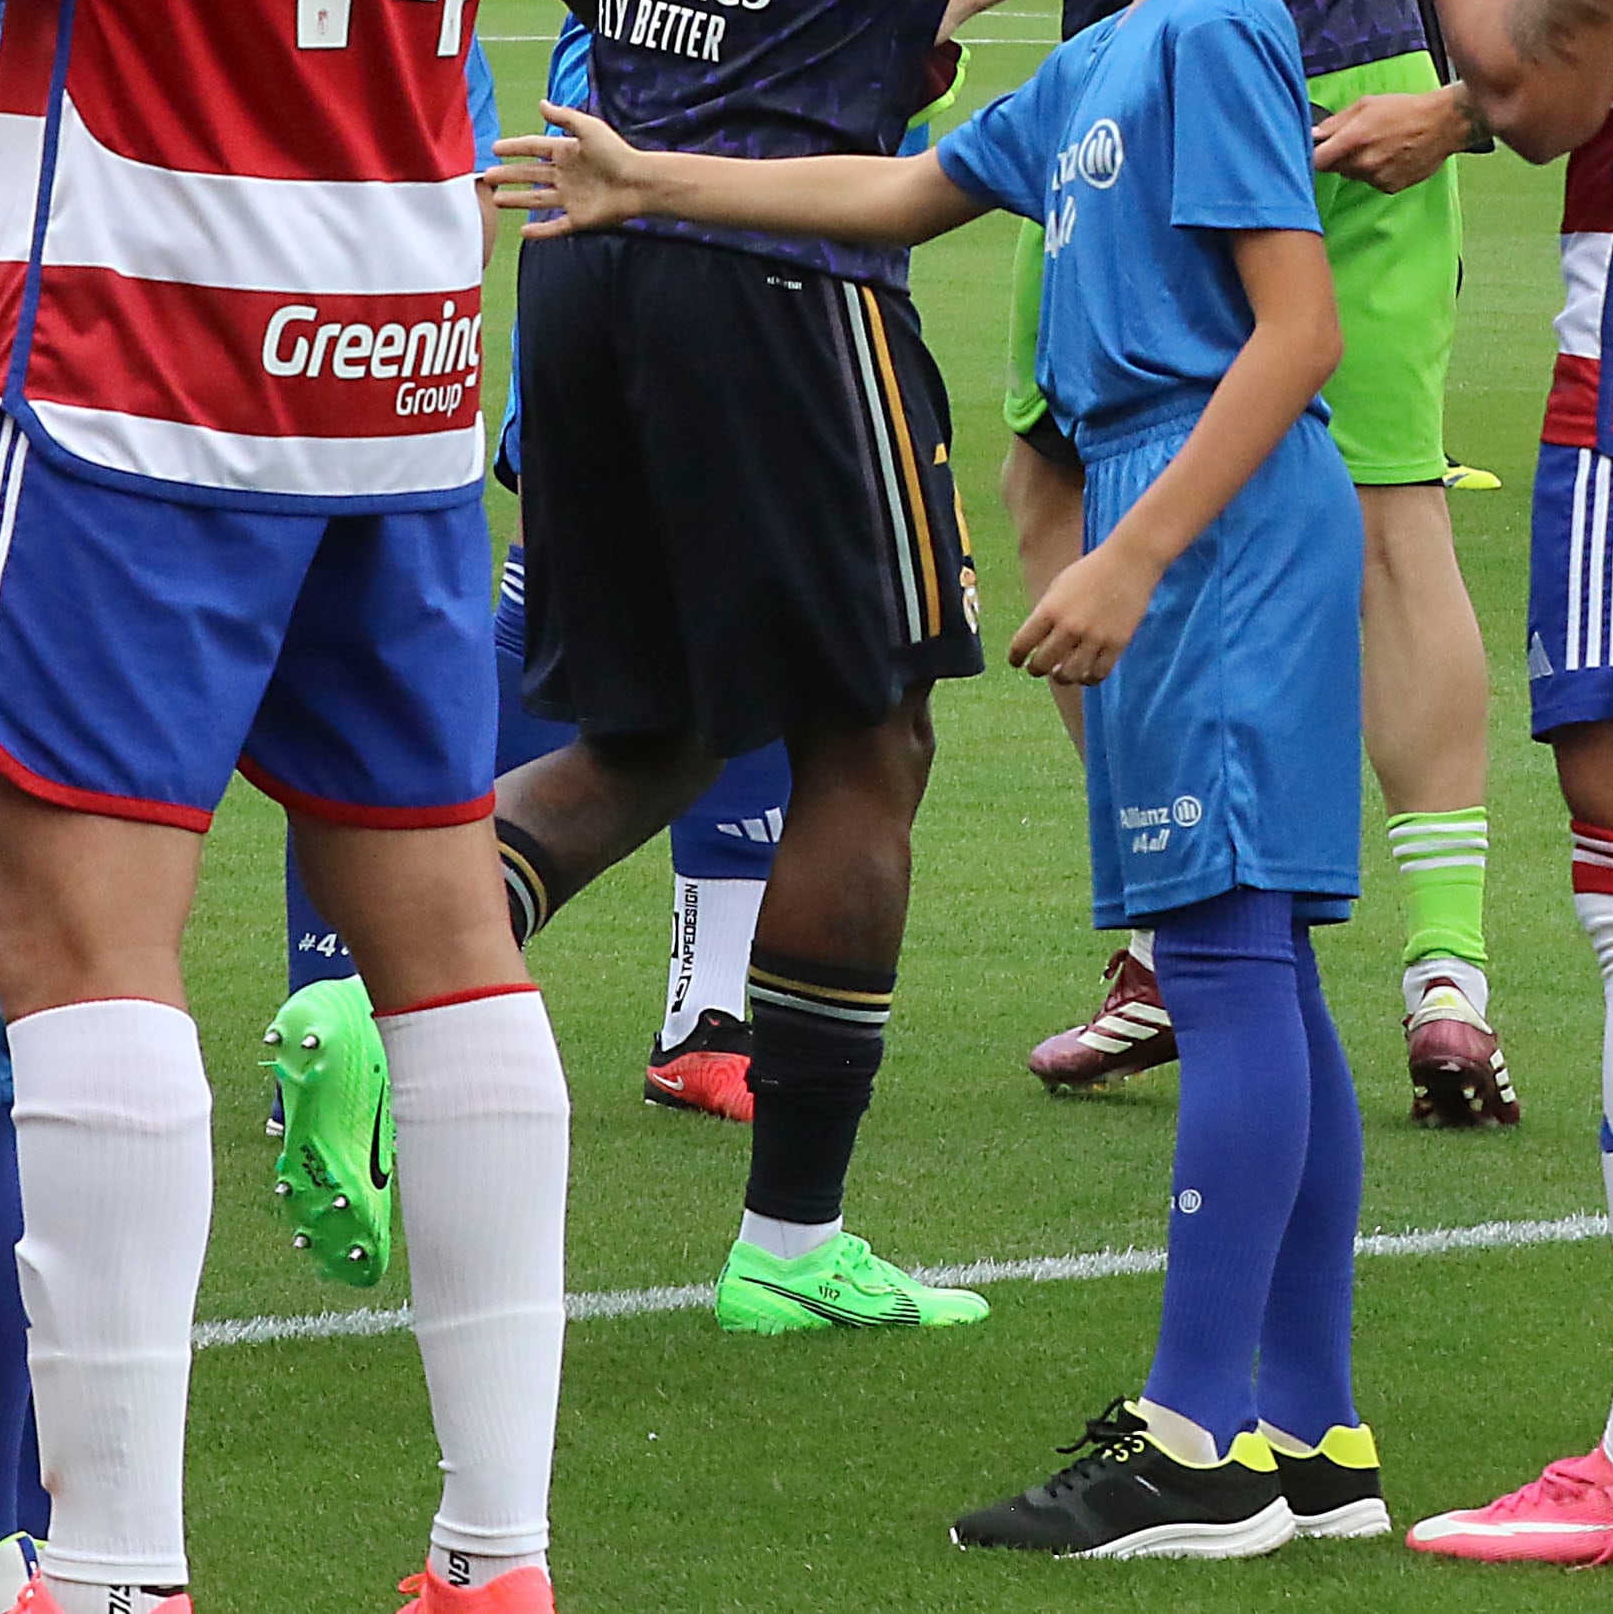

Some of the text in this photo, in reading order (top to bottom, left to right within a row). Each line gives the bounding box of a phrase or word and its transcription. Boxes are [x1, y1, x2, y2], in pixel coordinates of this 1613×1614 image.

[395, 382, 462, 418] Group
[1120, 807, 1171, 829] Allianz
[682, 883, 699, 973] TAPEDESIGN
